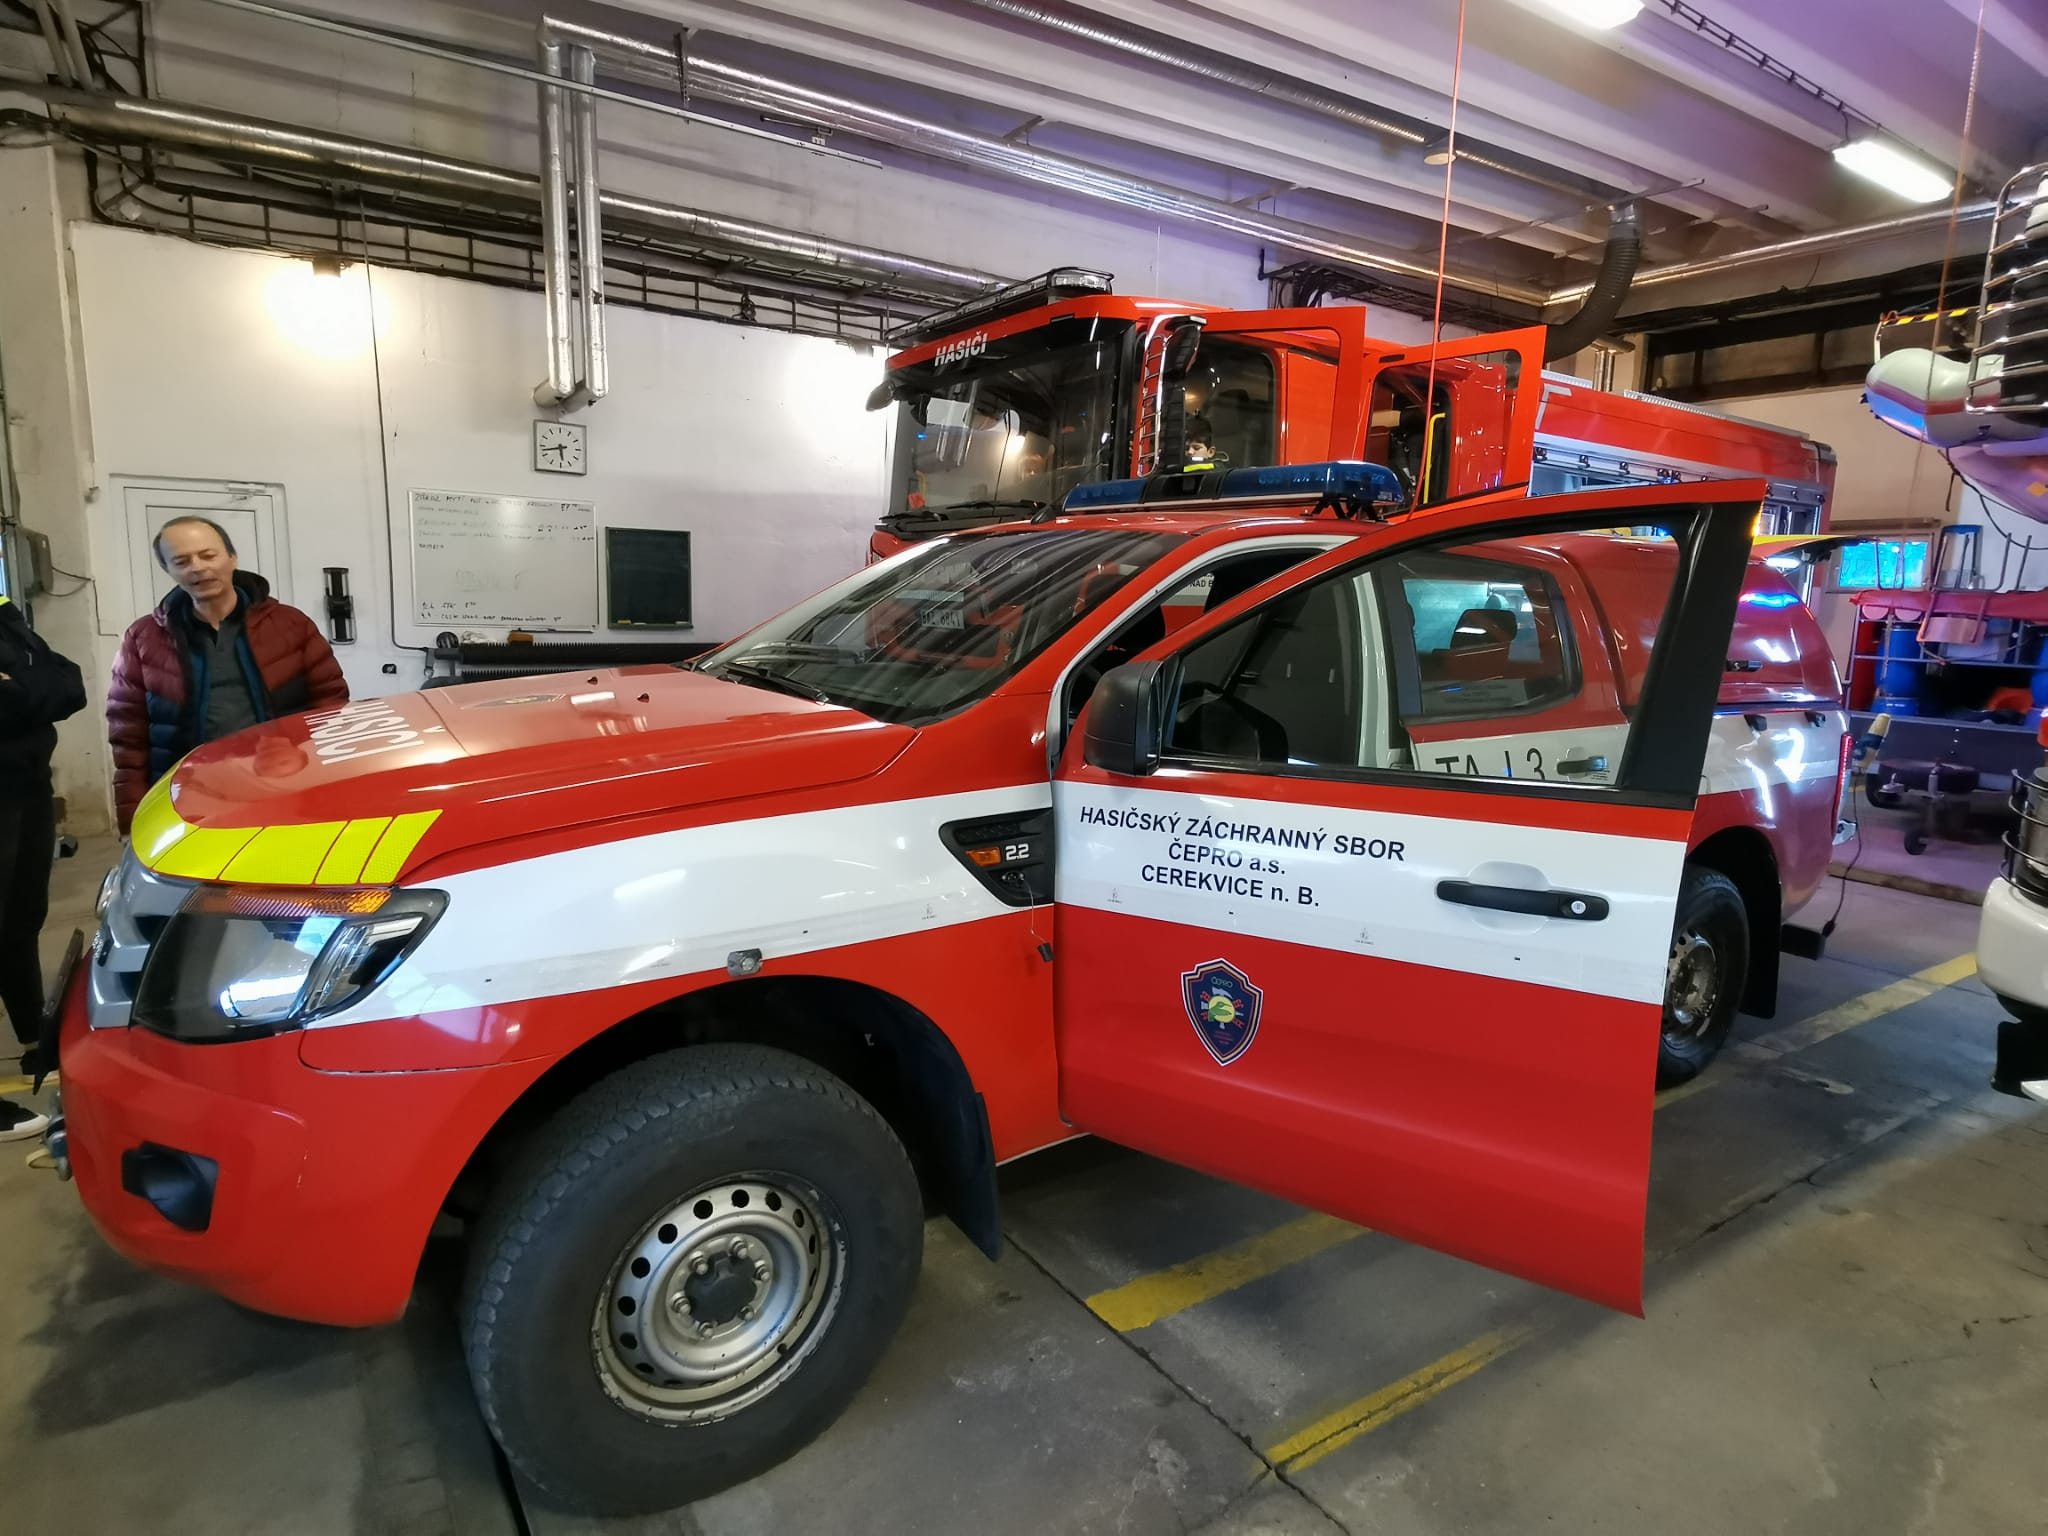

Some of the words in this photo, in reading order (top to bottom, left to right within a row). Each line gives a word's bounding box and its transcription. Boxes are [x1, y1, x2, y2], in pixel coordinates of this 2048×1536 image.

[934, 330, 988, 367] HASIČI
[303, 701, 446, 766] HASIČI
[1005, 843, 1030, 861] 2.2
[1080, 806, 1182, 834] HASIČSKÝ
[1185, 815, 1328, 851] ZÁCHRANNÝ
[1333, 834, 1405, 862] SBOR
[1168, 837, 1243, 868] ČEPRO
[1249, 857, 1286, 875] a.s.
[1141, 864, 1264, 899] CEREKVICE
[1271, 886, 1289, 902] n.
[1297, 885, 1319, 907] B.
